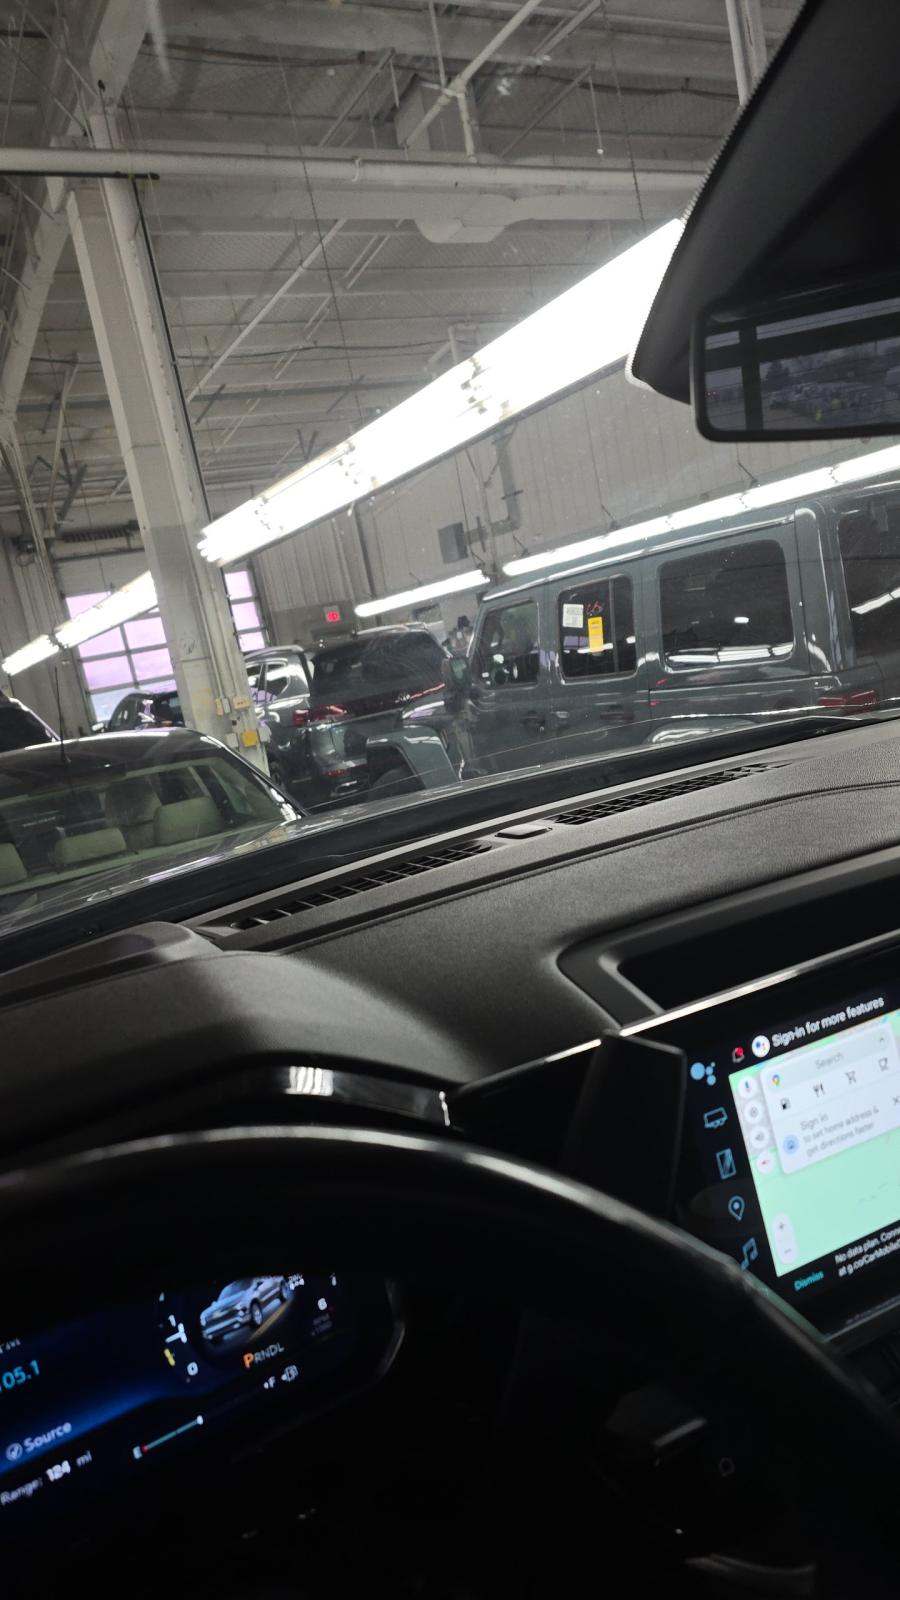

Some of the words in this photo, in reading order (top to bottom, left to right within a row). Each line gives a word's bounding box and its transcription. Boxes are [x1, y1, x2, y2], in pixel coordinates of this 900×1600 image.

[772, 1026, 806, 1047] Sign-in
[805, 1019, 821, 1034] for
[821, 1011, 846, 1028] more
[846, 997, 885, 1019] features
[815, 1052, 843, 1070] Search
[800, 1117, 820, 1131] Sign
[824, 1120, 844, 1132] home
[845, 1109, 872, 1125] address
[820, 1130, 854, 1150] directions
[834, 1252, 847, 1263] No
[847, 1245, 864, 1259] data
[794, 1271, 824, 1291] Dismiss
[0, 1359, 40, 1393] 05.1
[23, 1422, 72, 1452] Source
